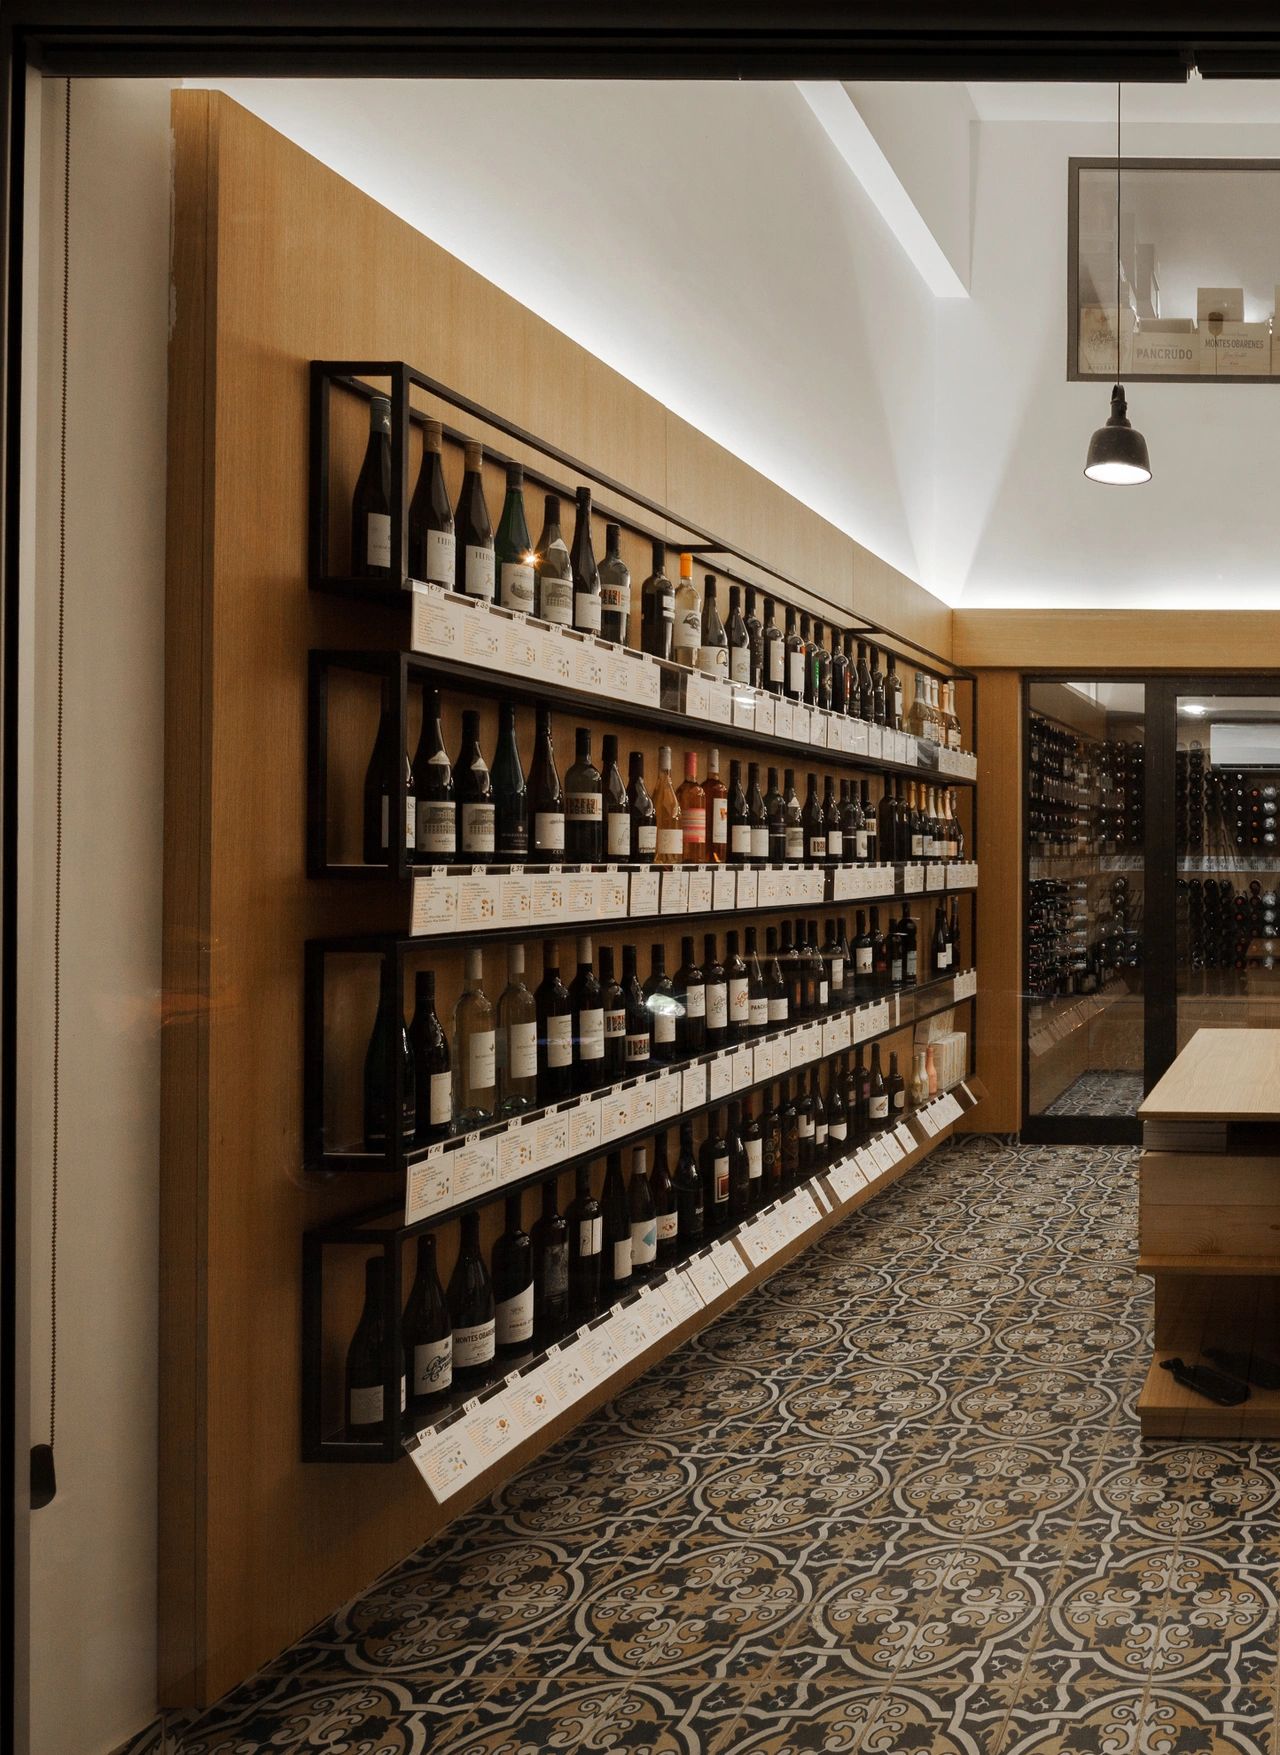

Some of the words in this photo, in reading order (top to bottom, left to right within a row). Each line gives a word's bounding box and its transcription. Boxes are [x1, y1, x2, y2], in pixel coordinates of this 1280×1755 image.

[1205, 339, 1231, 348] MONTES
[1136, 348, 1193, 360] PANCRUDO
[455, 1333, 479, 1345] MONTES
